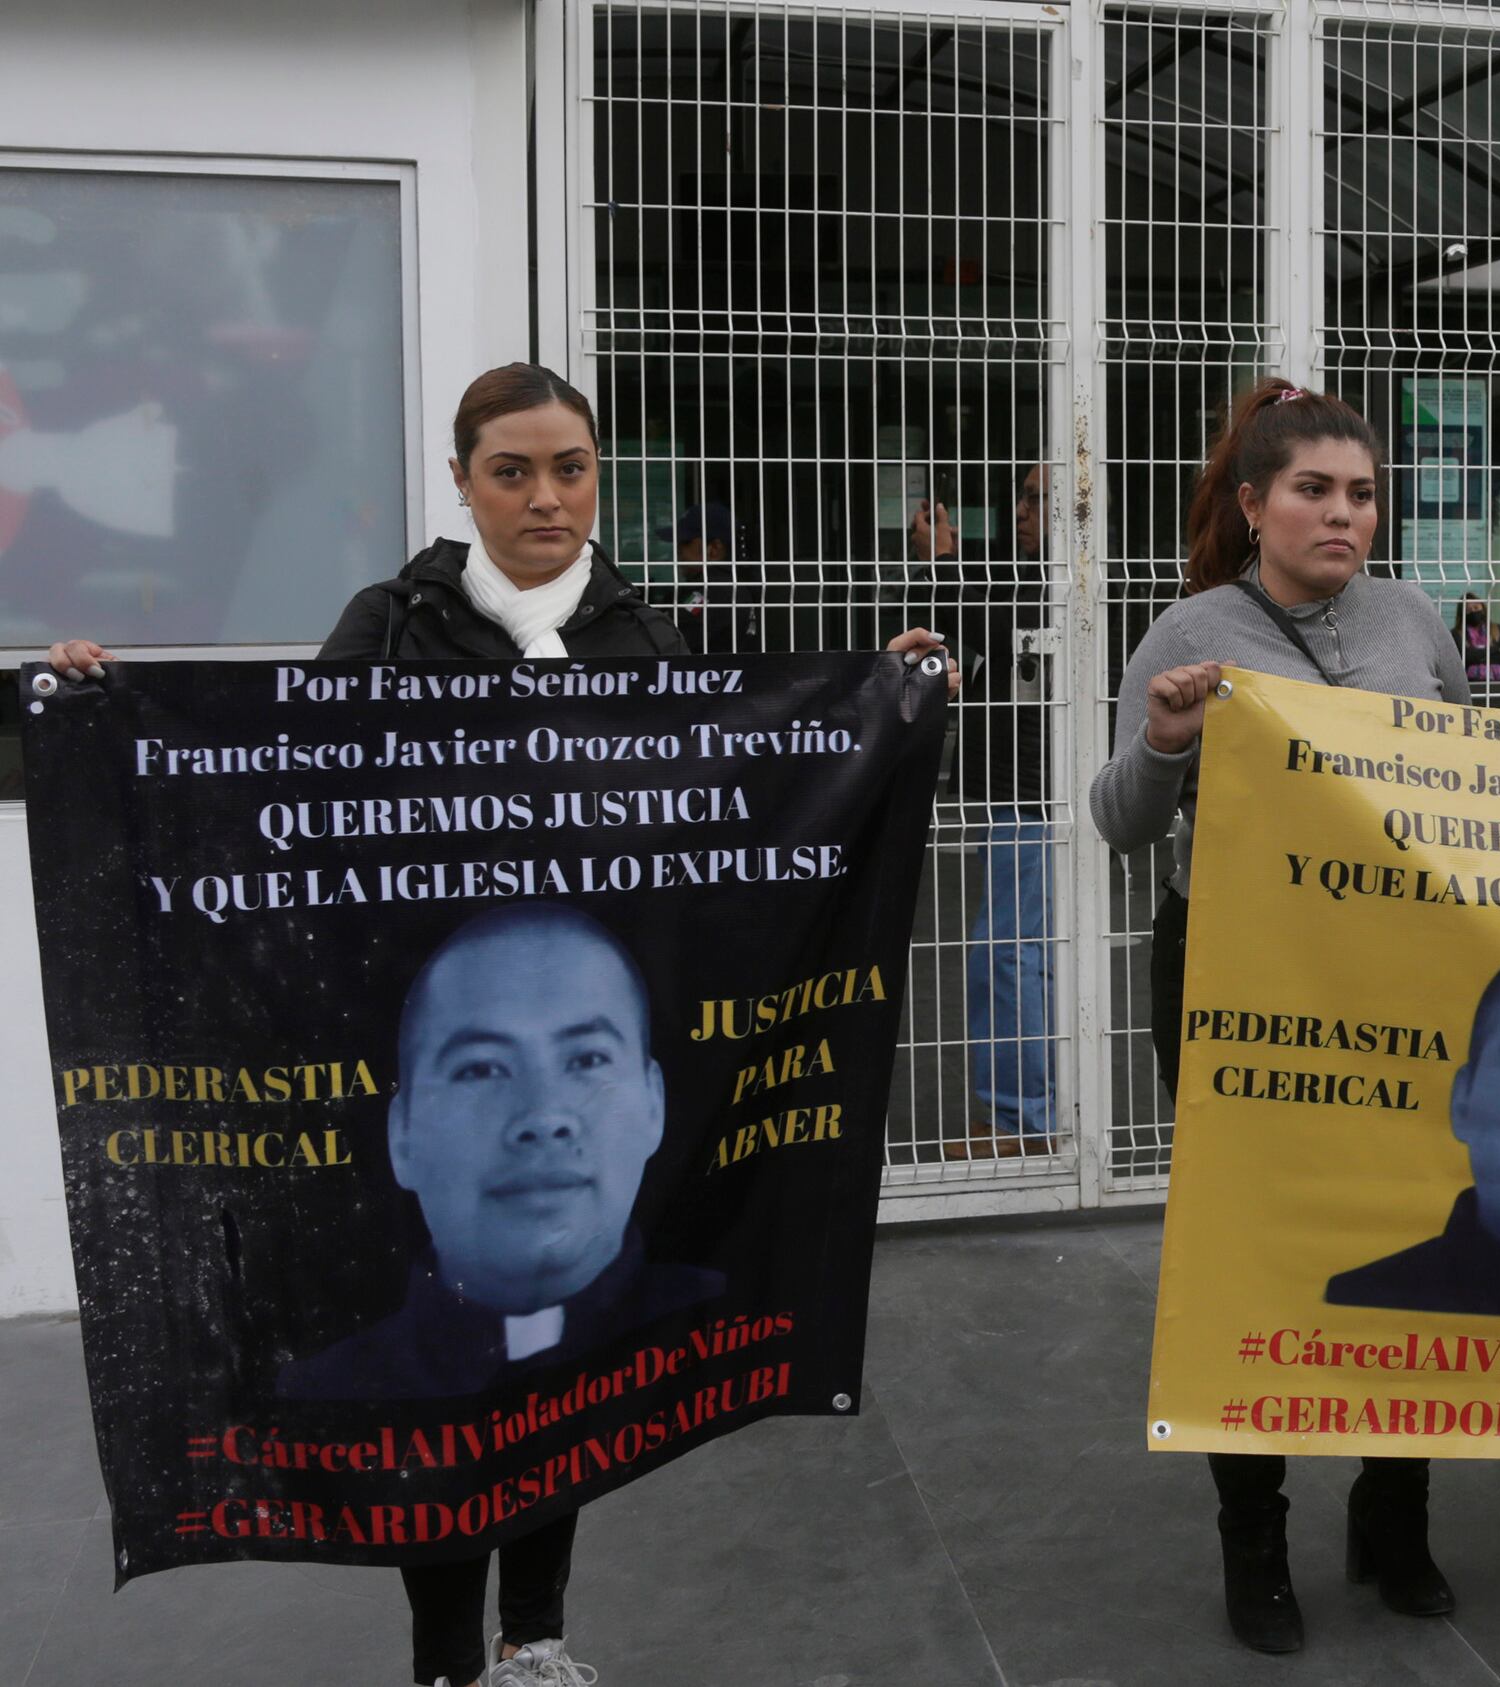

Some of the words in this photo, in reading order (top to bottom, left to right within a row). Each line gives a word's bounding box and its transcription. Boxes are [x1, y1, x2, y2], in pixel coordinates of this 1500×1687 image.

[277, 667, 358, 701] Por
[370, 667, 500, 699] Favor
[511, 664, 638, 697] Señor
[648, 662, 742, 694] Juez
[1392, 699, 1453, 733] Por
[136, 734, 363, 775] Francisco
[375, 729, 516, 767] Javier
[527, 728, 680, 762] Orozco
[691, 720, 862, 757] Treviño.
[1286, 739, 1461, 791] Francisco
[259, 794, 533, 850] QUEREMOS
[545, 787, 750, 828] JUSTICIA
[149, 875, 178, 913] Y
[193, 872, 294, 923] QUE
[305, 868, 367, 905] LA
[380, 859, 569, 901] IGLESIA
[581, 856, 641, 892] LO
[652, 845, 847, 887] EXPULSE.
[1286, 854, 1311, 885] Y
[1320, 860, 1405, 900] QUE
[1415, 871, 1467, 905] LA
[690, 964, 887, 1041] JUSTICIA
[1186, 1010, 1449, 1060] PEDERASTIA
[61, 1059, 379, 1106] PEDERASTIA
[732, 1038, 836, 1106] PARA
[1213, 1066, 1419, 1110] CLERICAL
[107, 1129, 351, 1167] CLERICAL
[706, 1103, 843, 1176] ABNER
[186, 1310, 794, 1472] #CárcelAlVioladorDeNiños
[176, 1361, 791, 1545] #GERARDOESPINOSARUBI
